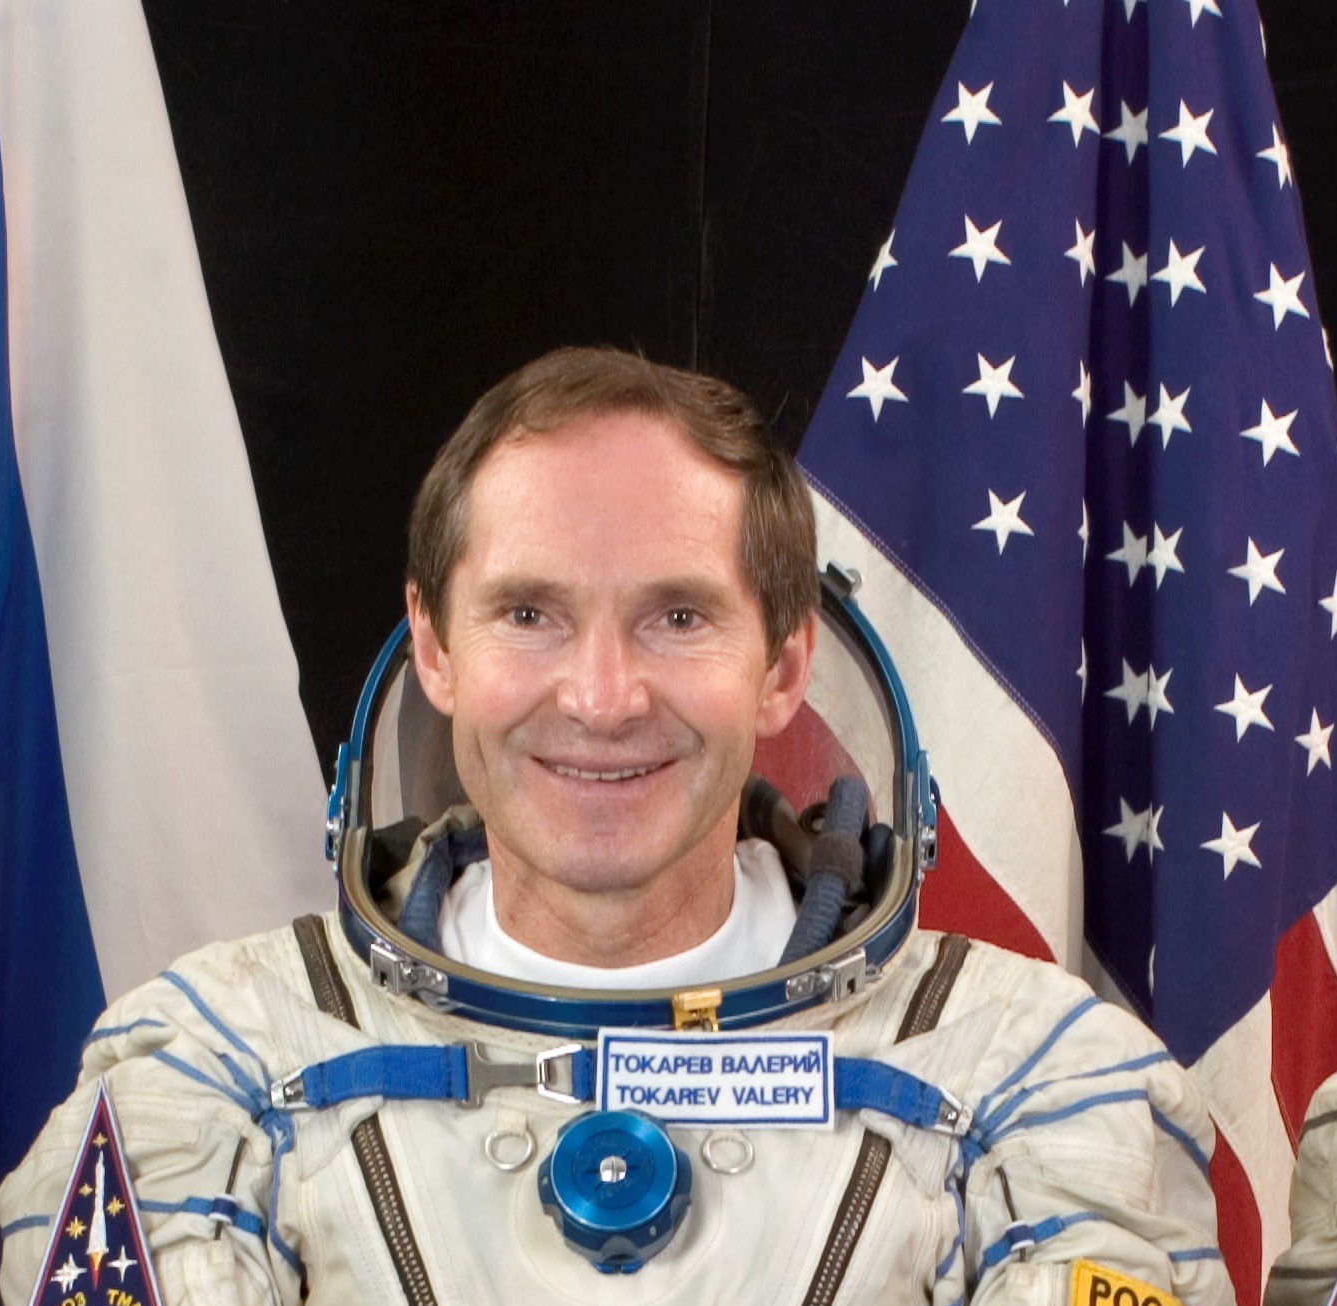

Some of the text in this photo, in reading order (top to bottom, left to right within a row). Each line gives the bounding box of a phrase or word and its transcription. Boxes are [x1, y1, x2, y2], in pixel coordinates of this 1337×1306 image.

[610, 1049, 821, 1075] ТОКАРЕВ ВАЛЕРИЙ
[616, 1085, 814, 1106] TOKAREV VALERY
